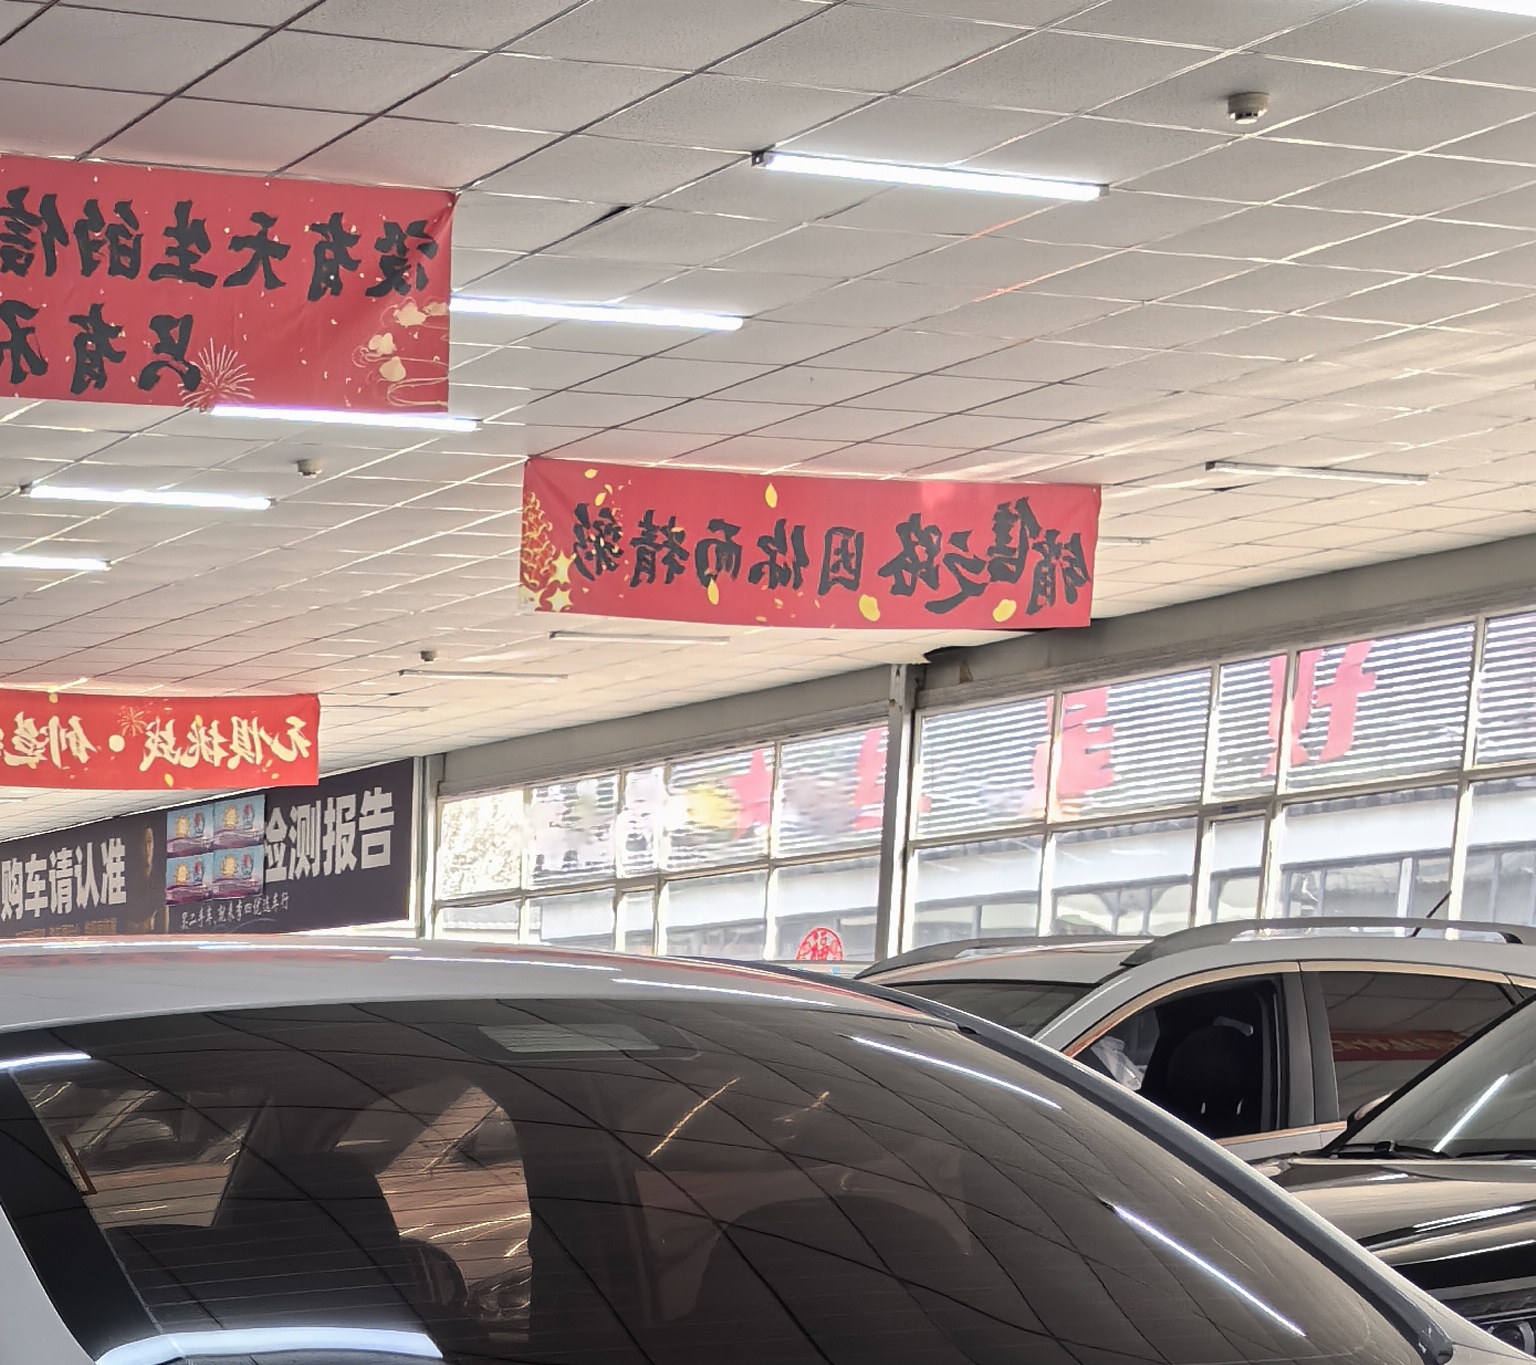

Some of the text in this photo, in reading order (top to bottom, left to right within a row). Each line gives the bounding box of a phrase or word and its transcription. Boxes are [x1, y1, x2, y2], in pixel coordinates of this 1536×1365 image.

[0, 836, 128, 922] 购车请认准
